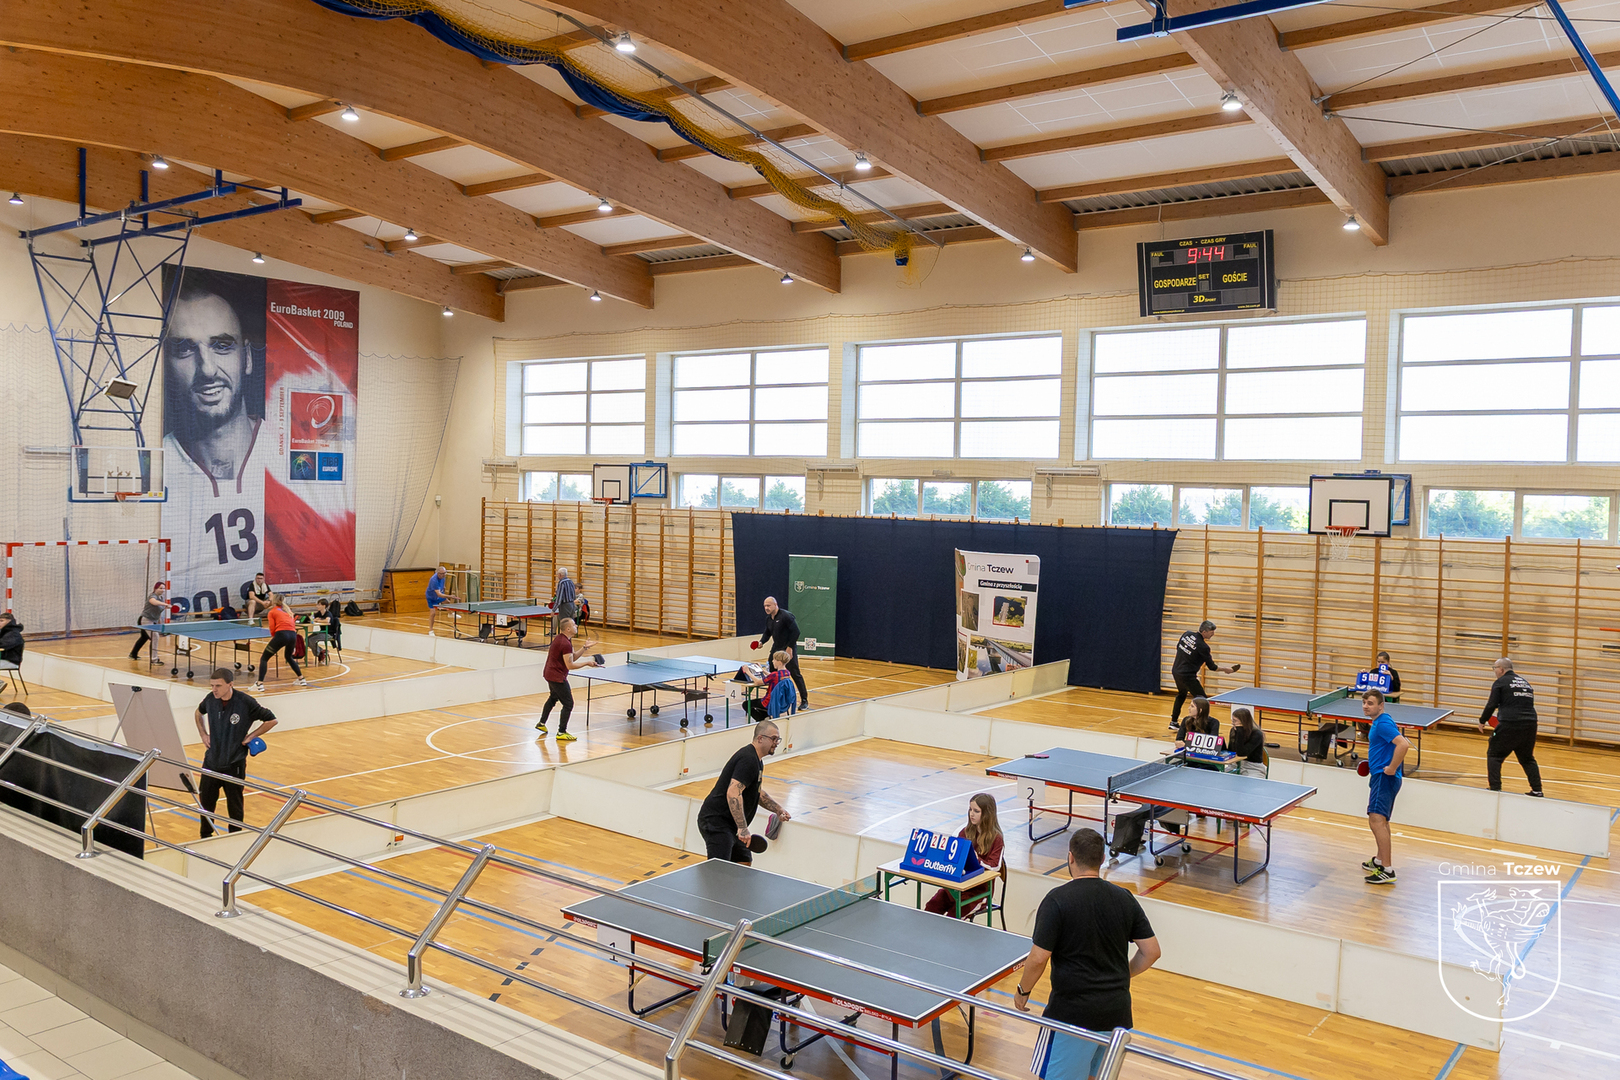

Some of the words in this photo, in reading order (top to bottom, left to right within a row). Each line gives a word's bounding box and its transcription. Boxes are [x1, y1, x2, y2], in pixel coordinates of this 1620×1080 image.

[1154, 277, 1197, 289] GOSPODARZE
[1222, 271, 1248, 283] GOŚCIE
[270, 301, 321, 318] EuroBasket
[323, 308, 345, 321] 2009
[333, 320, 354, 329] POLAND
[321, 456, 339, 466] FIBA
[205, 508, 258, 565] 13
[987, 564, 1014, 574] Tczew
[1379, 676, 1385, 685] 6
[730, 690, 736, 699] 4
[1195, 735, 1202, 745] 0
[1207, 737, 1214, 747] 0
[1195, 748, 1218, 757] Butterfly
[1027, 787, 1034, 800] 2
[914, 831, 929, 854] 10
[932, 835, 938, 847] 2
[941, 837, 946, 848] 2
[948, 839, 958, 861] 9
[924, 859, 957, 875] Butterfly
